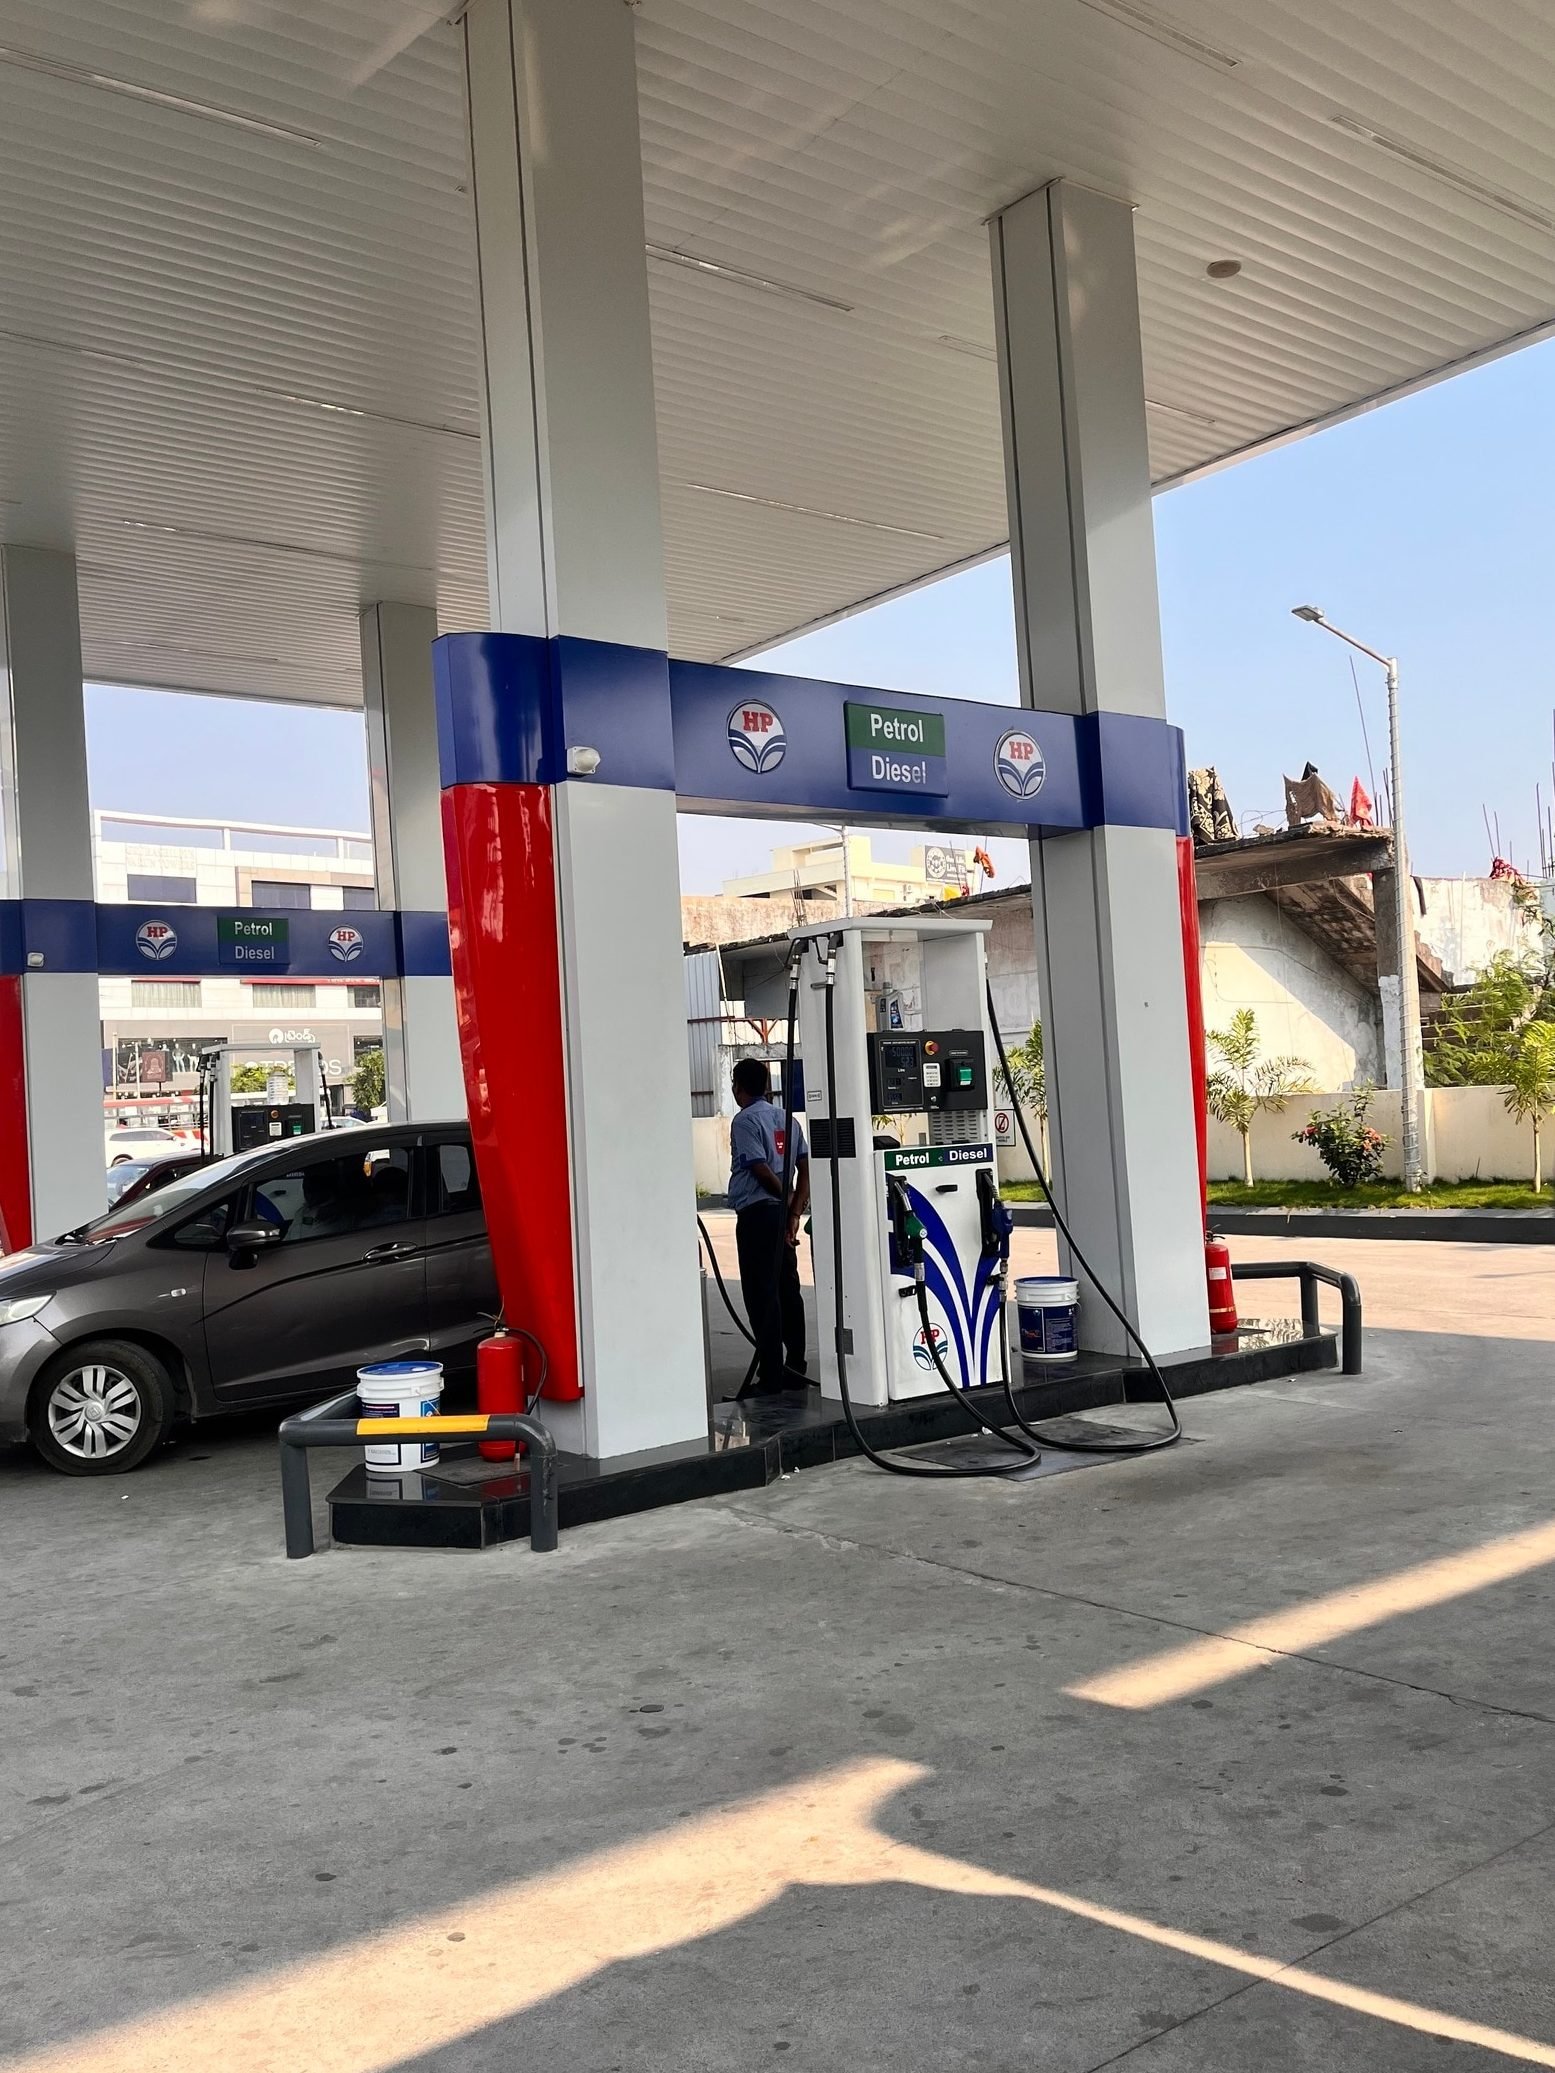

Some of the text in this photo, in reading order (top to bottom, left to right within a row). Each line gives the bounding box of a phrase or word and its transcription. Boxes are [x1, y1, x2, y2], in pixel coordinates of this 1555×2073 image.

[742, 711, 774, 733] HP
[871, 714, 924, 743] Petrol
[1008, 741, 1034, 761] HP
[872, 756, 927, 784] Diesel
[147, 926, 168, 938] HP
[235, 921, 273, 936] Petrol
[337, 931, 356, 942] HP
[235, 945, 275, 960] Diesel
[895, 1148, 987, 1166] Petrol Diesel
